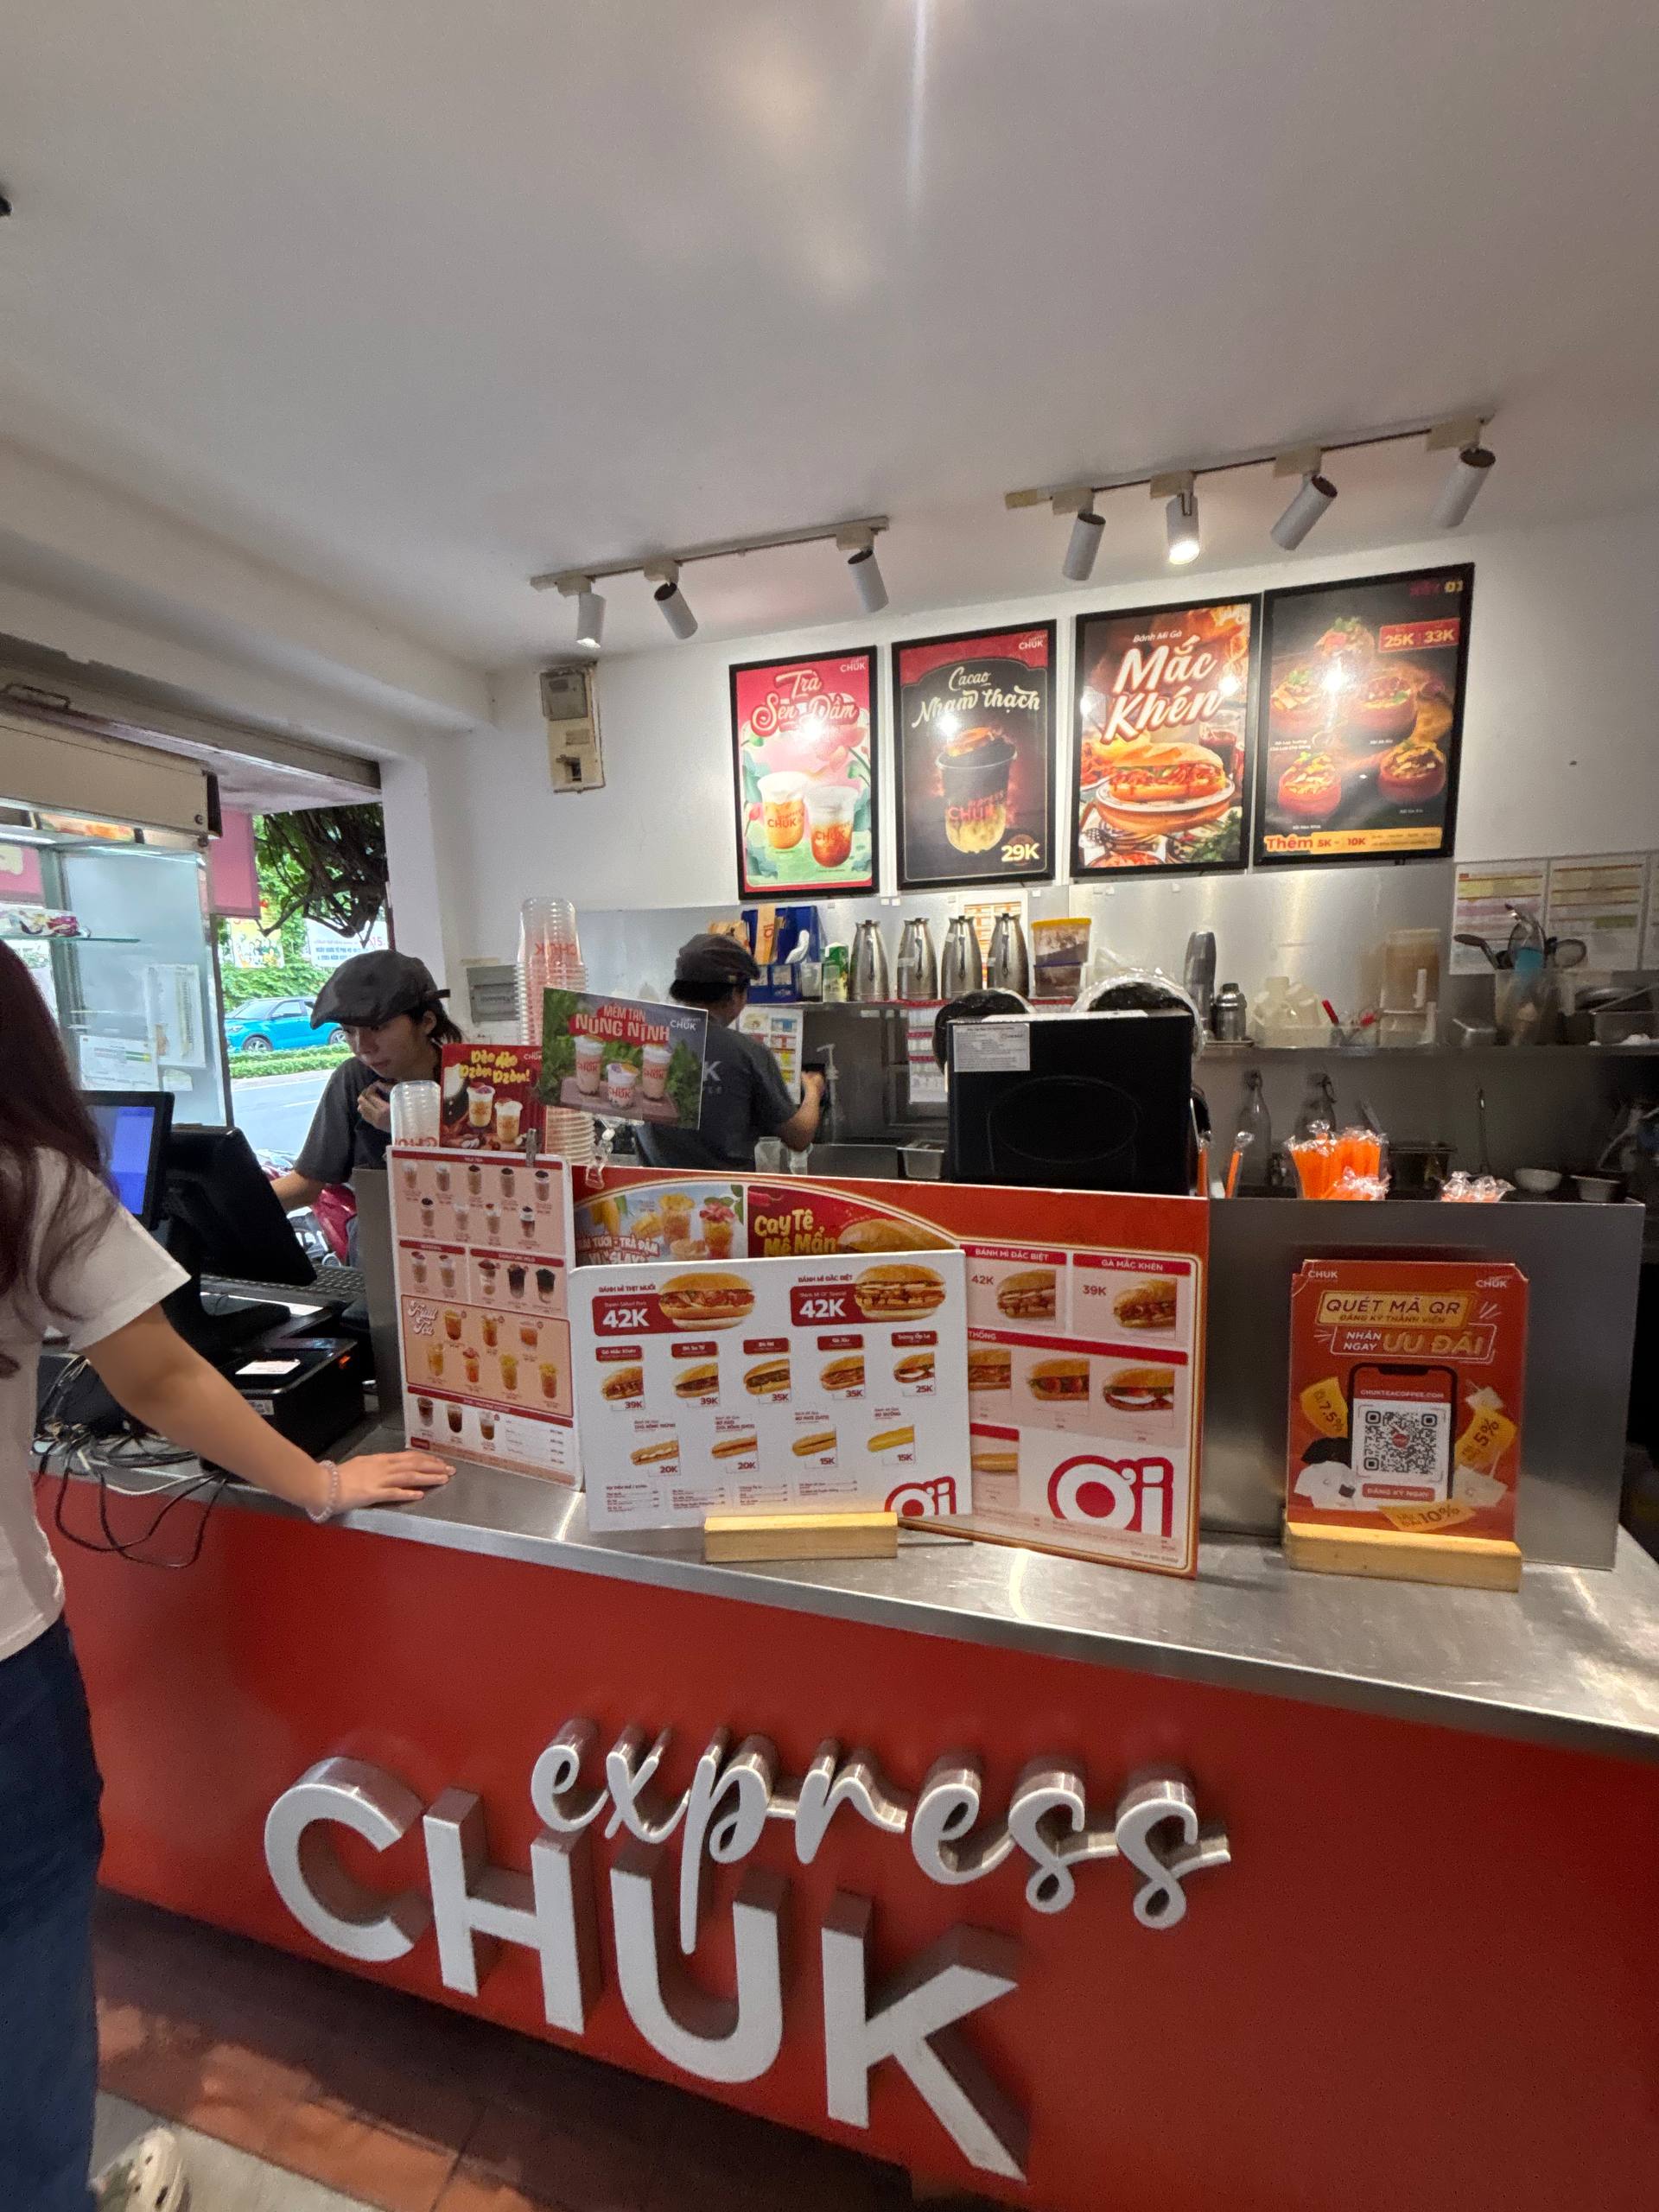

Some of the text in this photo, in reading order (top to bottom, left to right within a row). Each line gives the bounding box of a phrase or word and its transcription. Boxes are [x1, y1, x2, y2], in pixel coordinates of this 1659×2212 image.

[1383, 632, 1414, 648] 25K
[1423, 628, 1454, 644] 33K
[1019, 640, 1044, 650] CHUK
[840, 662, 866, 673] CHUK
[1112, 635, 1218, 694] Mắc
[775, 669, 823, 700] Trà
[948, 666, 992, 691] Cacao
[1104, 685, 1224, 741] Khén
[767, 817, 797, 829] CHUK
[1266, 836, 1313, 849] Thêm
[1348, 836, 1366, 846] 10K
[1001, 842, 1040, 862] 29K
[670, 1020, 696, 1031] CHUK
[753, 1209, 814, 1237] Cay Tê
[975, 1248, 998, 1257] BÁNH
[1101, 1258, 1115, 1267] GÀ
[971, 1275, 995, 1285] 42K
[1475, 1279, 1507, 1288] CHUK
[1083, 1285, 1107, 1296] 39K
[799, 1299, 847, 1318] 42K
[1326, 1296, 1461, 1314] QUÉT MÃ QR
[602, 1308, 651, 1328] 42K
[1344, 1342, 1377, 1351] NGAY
[1431, 1332, 1484, 1356] ĐÃI
[916, 1384, 933, 1393] 25K
[772, 1393, 789, 1402] 35K
[1473, 1417, 1499, 1446] 5%
[1419, 1503, 1460, 1524] 10%
[531, 1735, 1232, 1955] express
[264, 1771, 1028, 2184] CHUK
